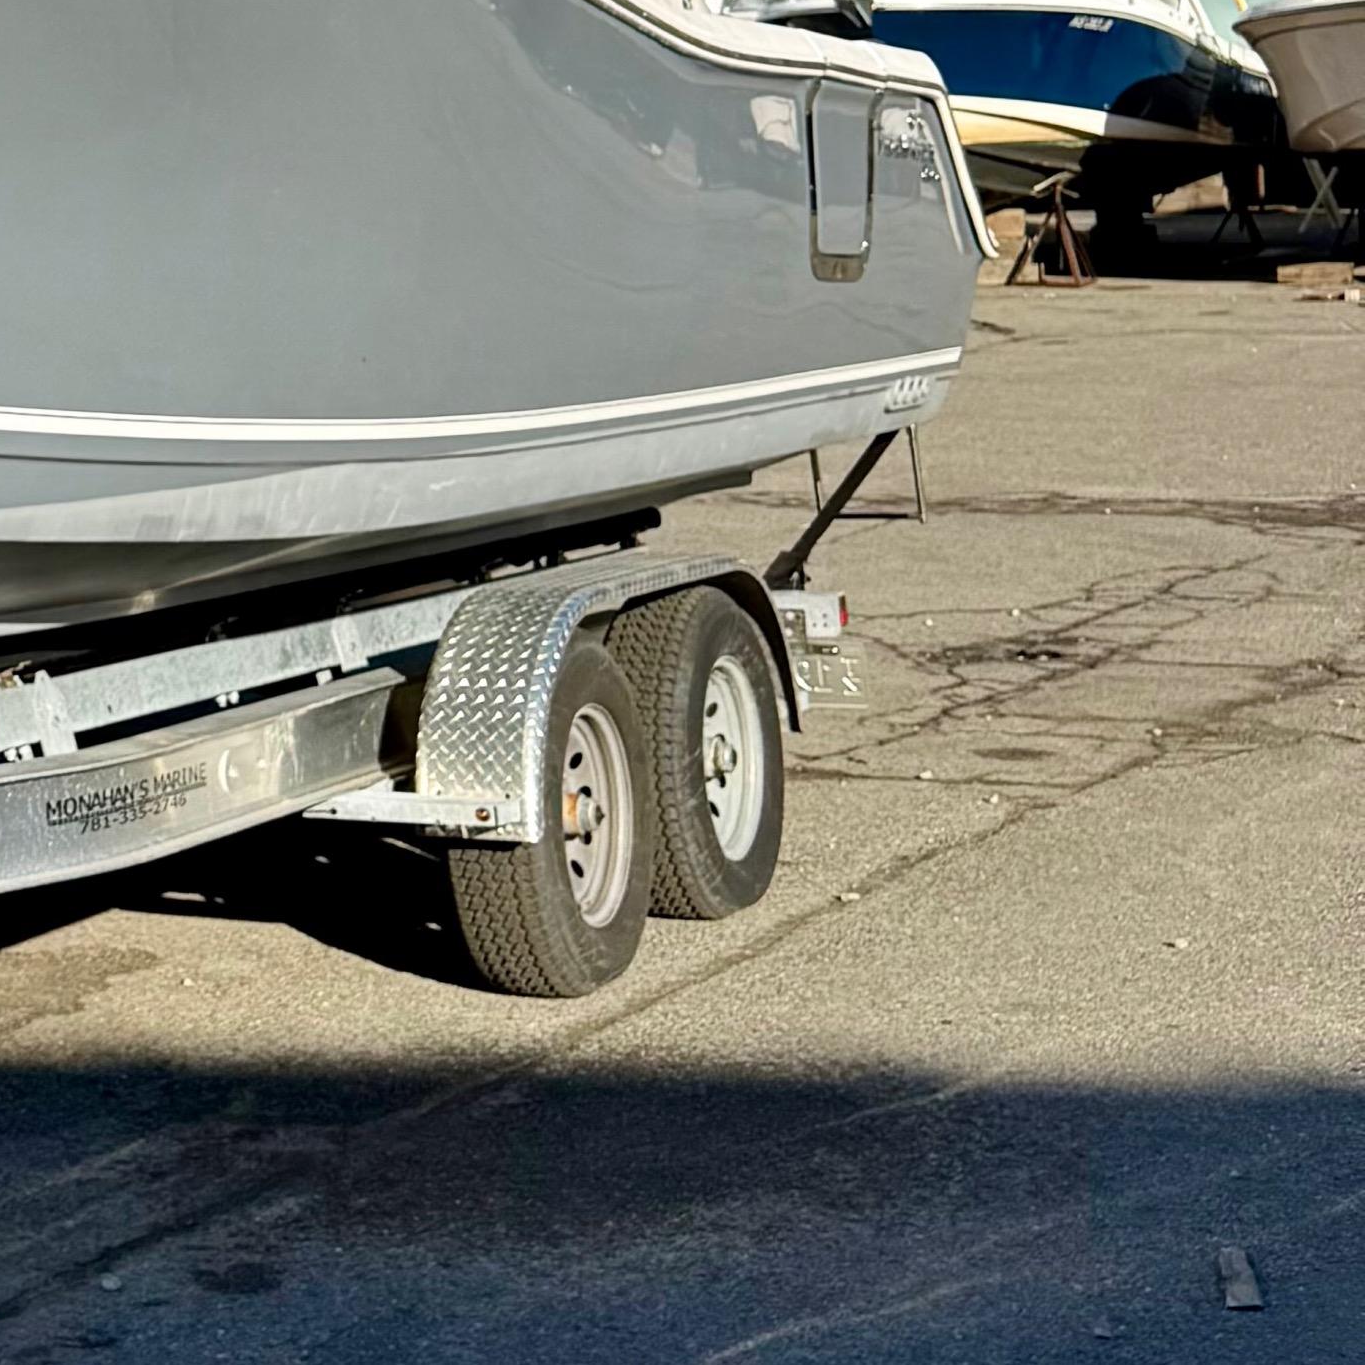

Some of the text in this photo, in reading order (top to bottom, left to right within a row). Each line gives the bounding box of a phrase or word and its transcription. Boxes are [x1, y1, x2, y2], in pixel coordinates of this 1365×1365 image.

[45, 761, 208, 820] MONAHAN'S MARINE
[80, 793, 187, 834] 781-335-2746
